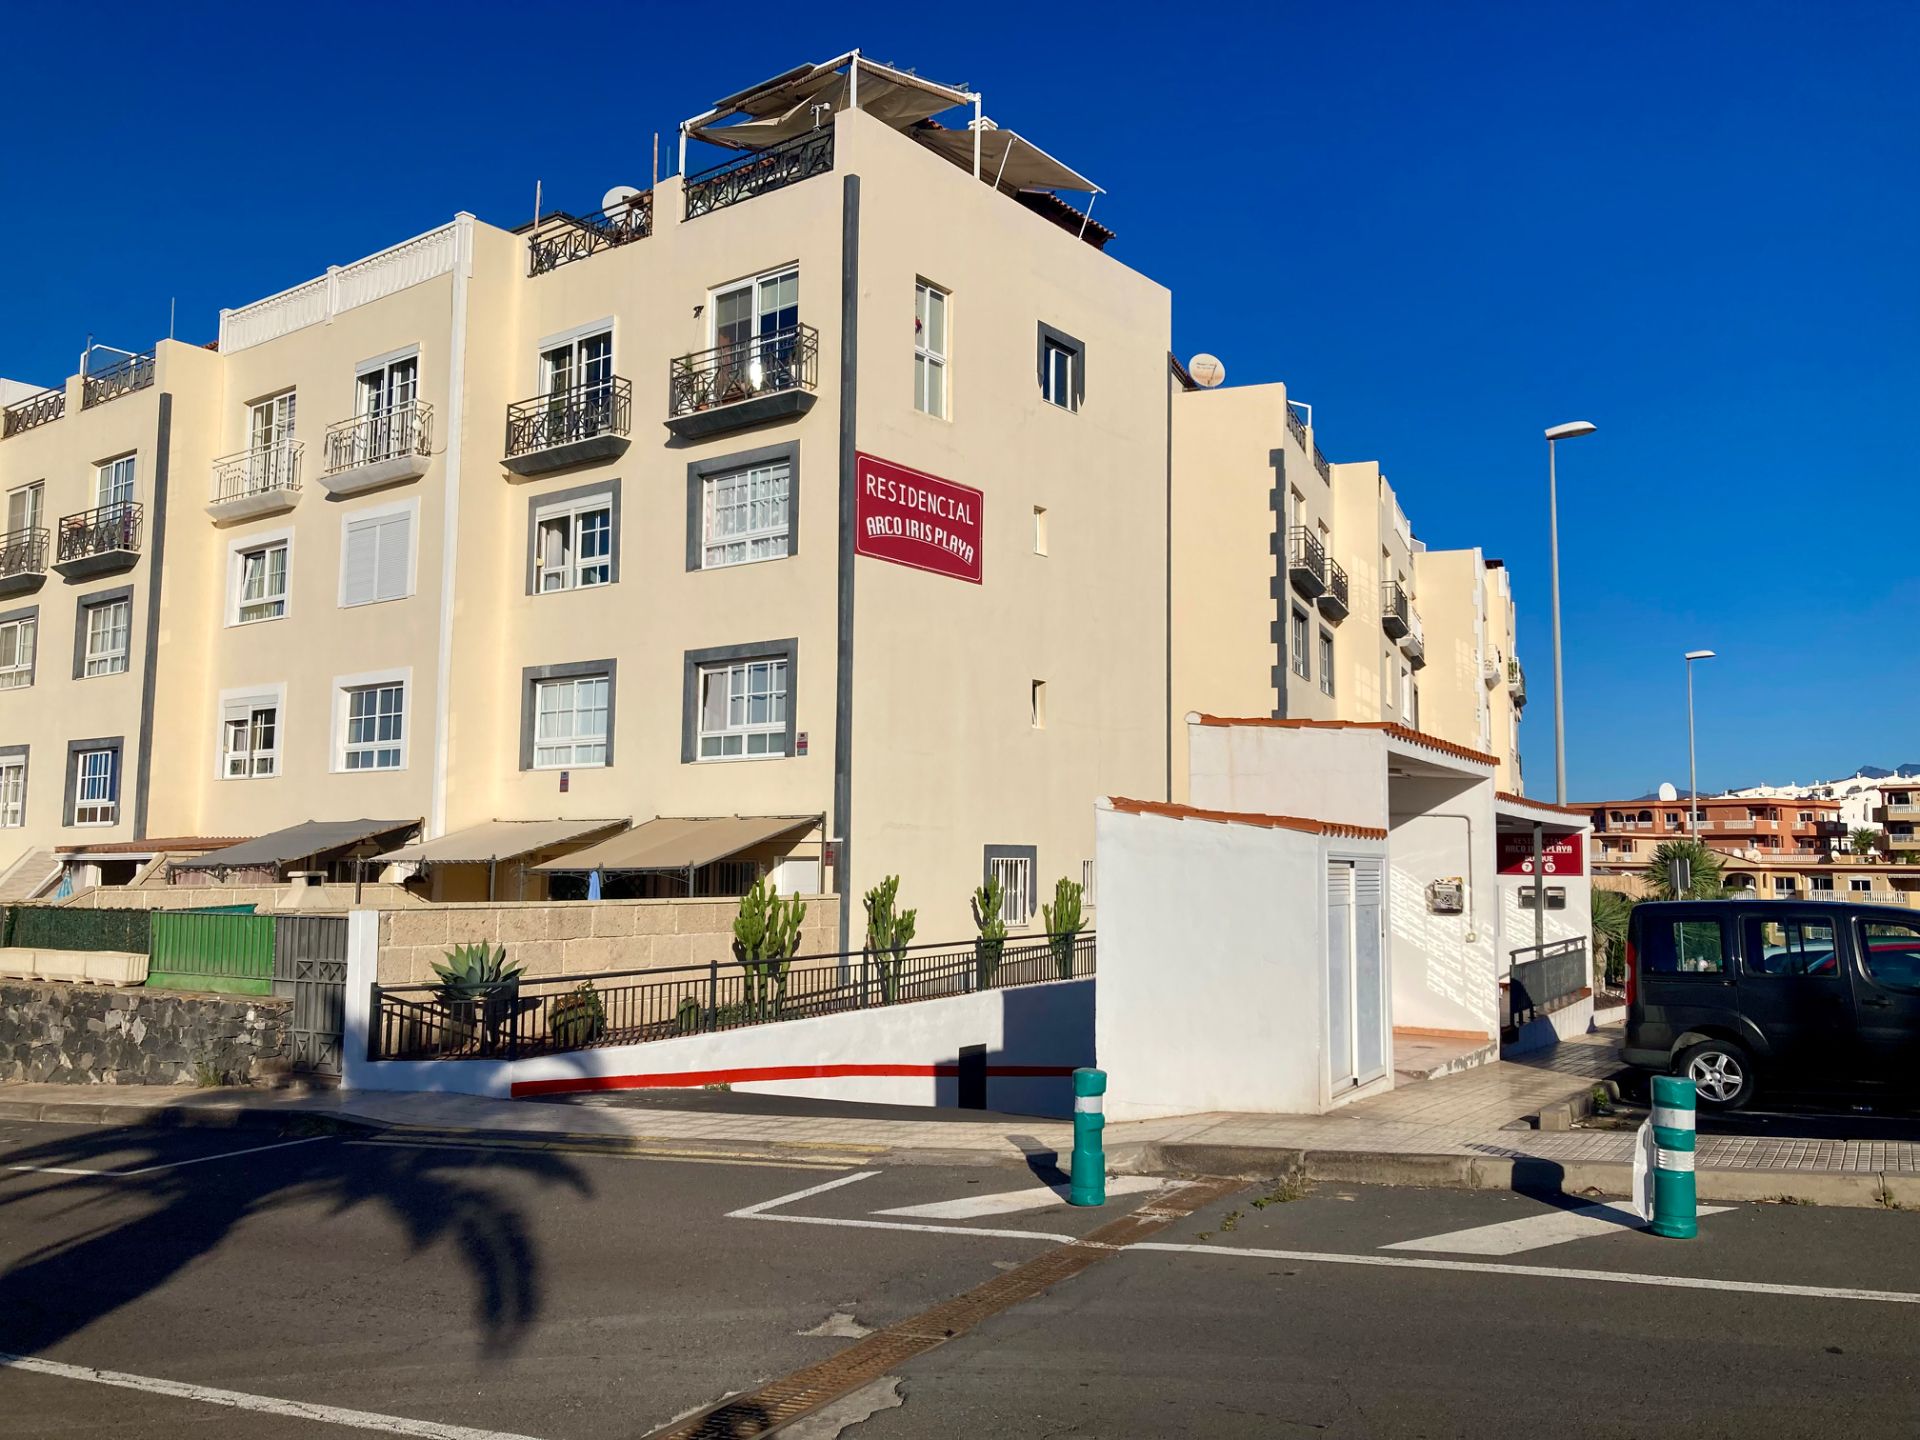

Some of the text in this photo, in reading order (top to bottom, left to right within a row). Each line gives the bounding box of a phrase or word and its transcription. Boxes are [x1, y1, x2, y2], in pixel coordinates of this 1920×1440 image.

[866, 473, 974, 526] RESIDENCIAL
[866, 516, 974, 563] ARCO IRIS PLAYA
[1546, 845, 1573, 853] PLAYA
